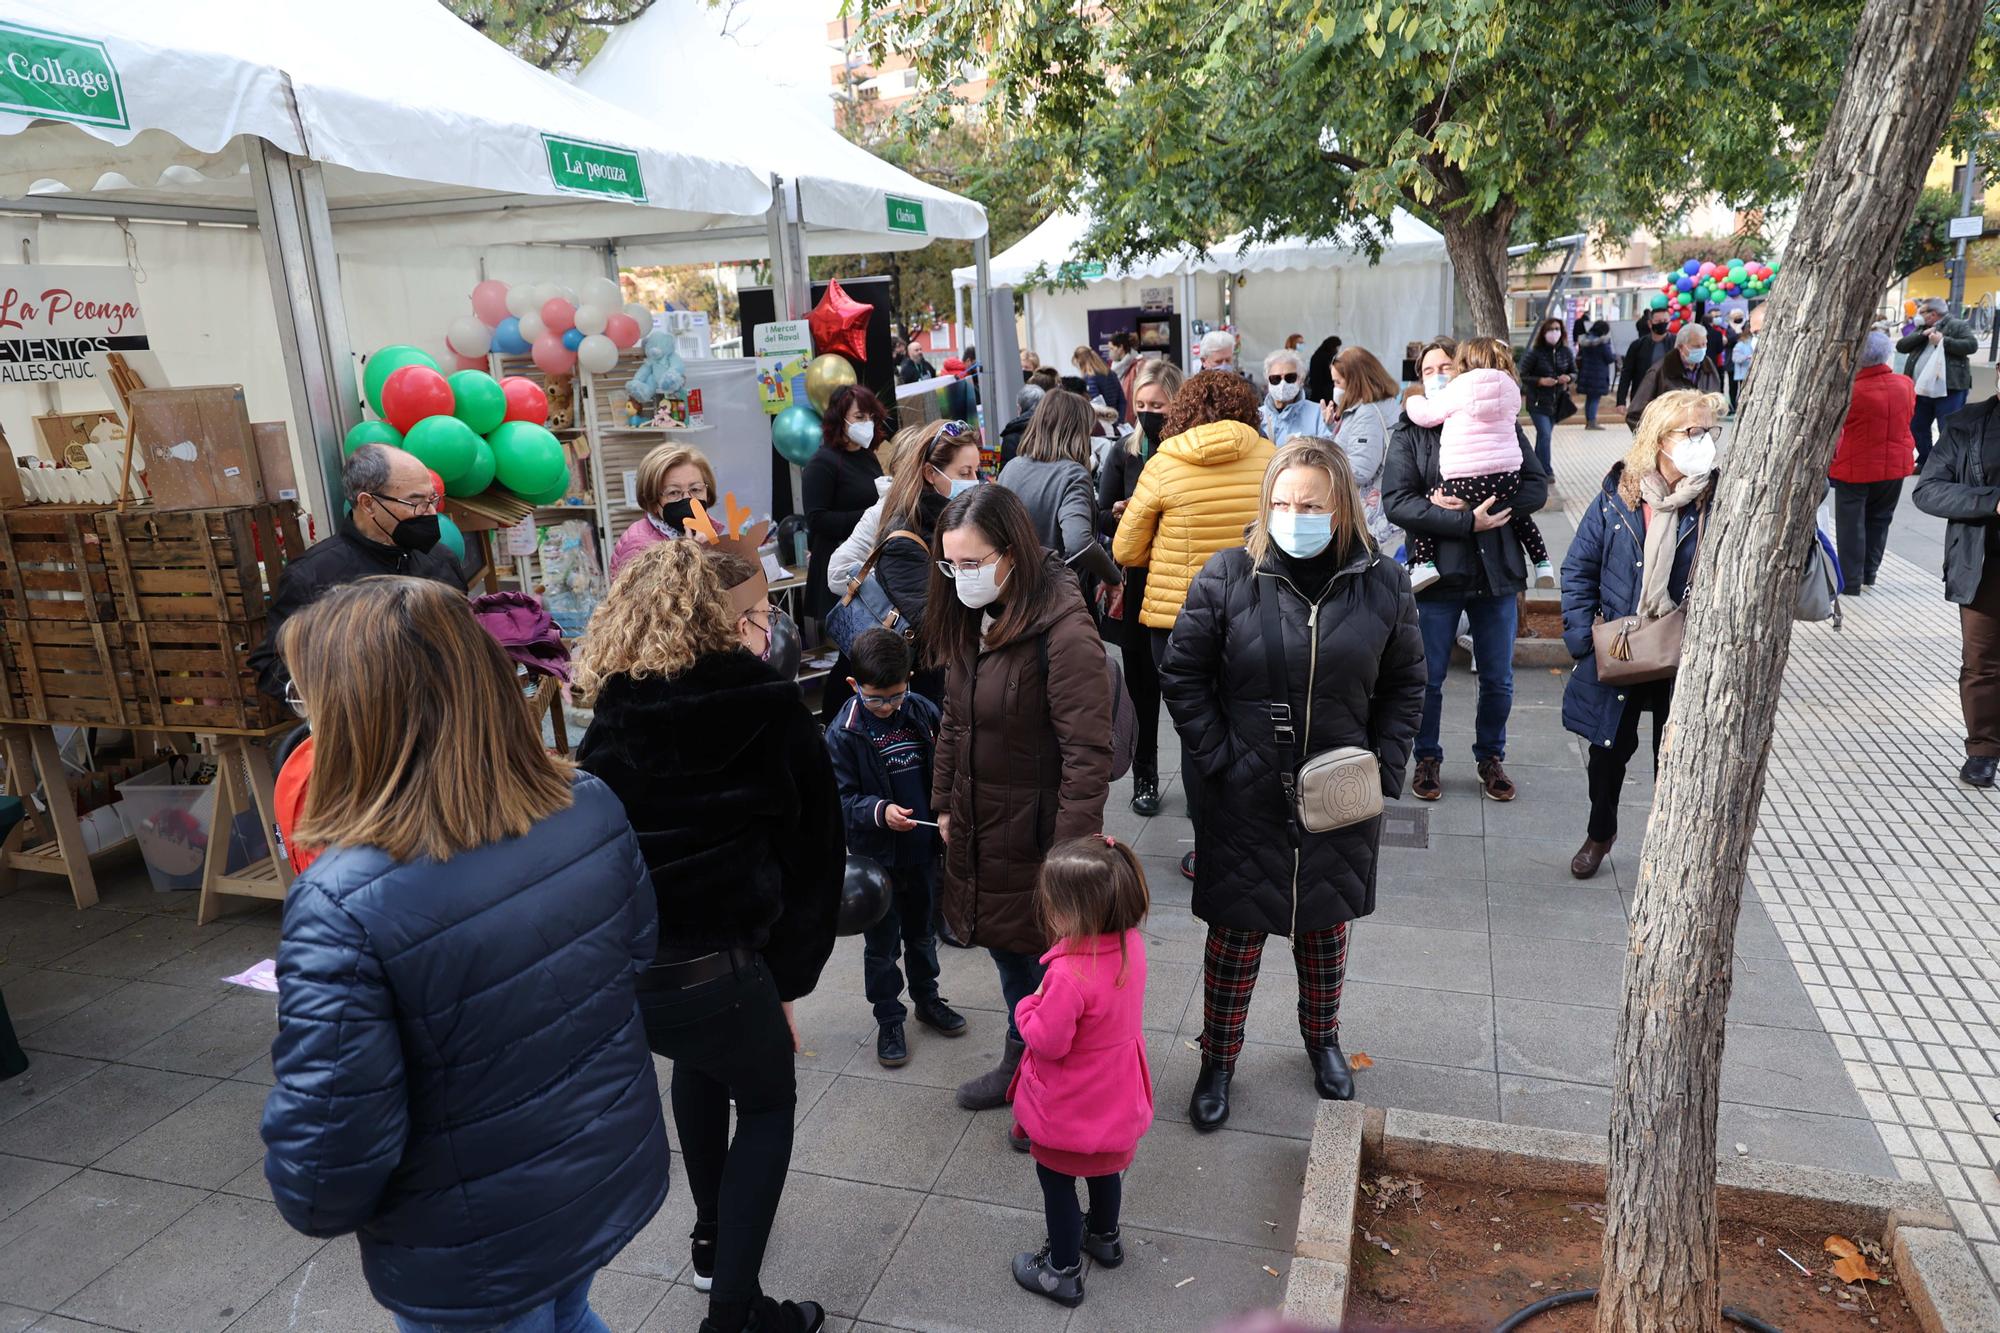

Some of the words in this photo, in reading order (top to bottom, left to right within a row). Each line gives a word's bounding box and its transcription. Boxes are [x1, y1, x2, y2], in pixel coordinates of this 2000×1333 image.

[7, 52, 109, 98] Collage
[563, 152, 584, 175] La
[585, 161, 627, 182] peonza
[0, 288, 39, 330] La
[40, 288, 139, 334] Peonza
[764, 334, 776, 343] del
[778, 332, 800, 342] Raval
[770, 324, 797, 333] Mercat
[1329, 766, 1361, 783] TOUS
